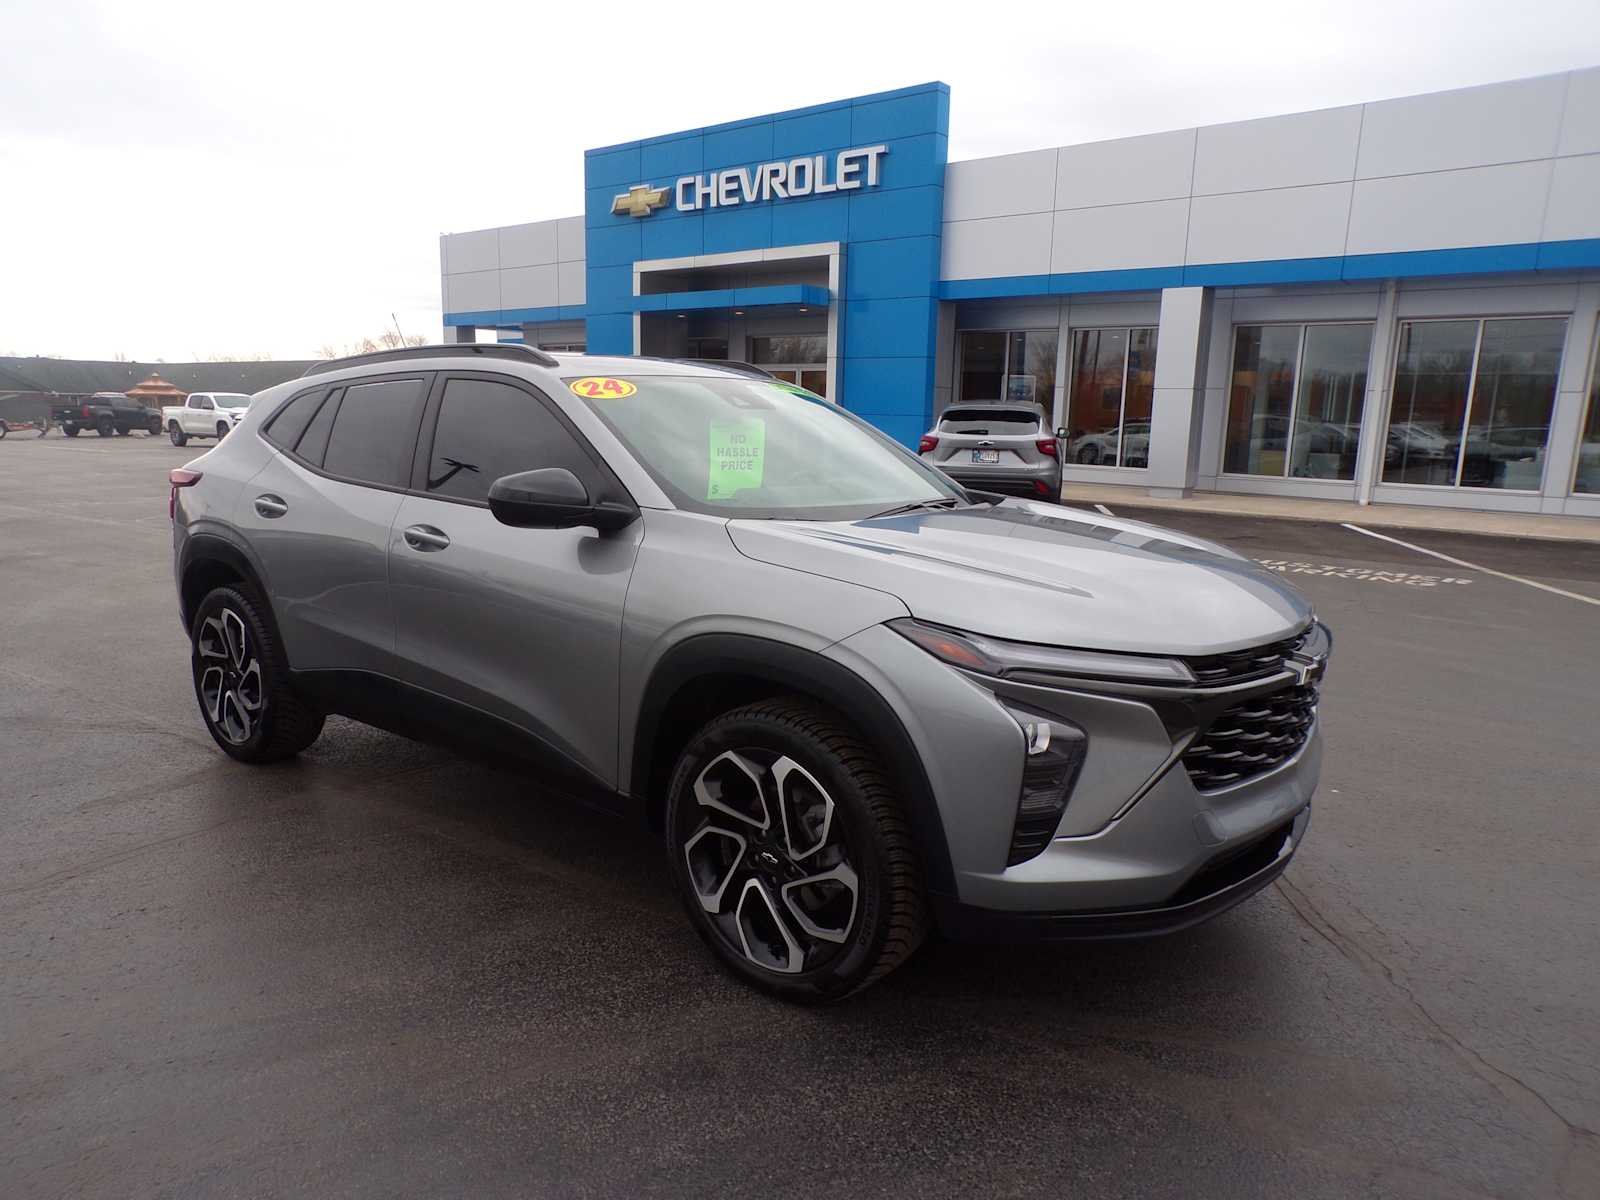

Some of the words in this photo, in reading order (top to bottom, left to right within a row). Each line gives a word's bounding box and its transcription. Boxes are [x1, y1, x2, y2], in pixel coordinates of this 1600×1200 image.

[675, 144, 888, 212] CHEVROLET
[582, 379, 623, 396] 24
[730, 433, 746, 444] NO
[717, 447, 759, 457] HASSLE
[720, 460, 753, 471] PRICE
[1264, 565, 1438, 587] ARKING
